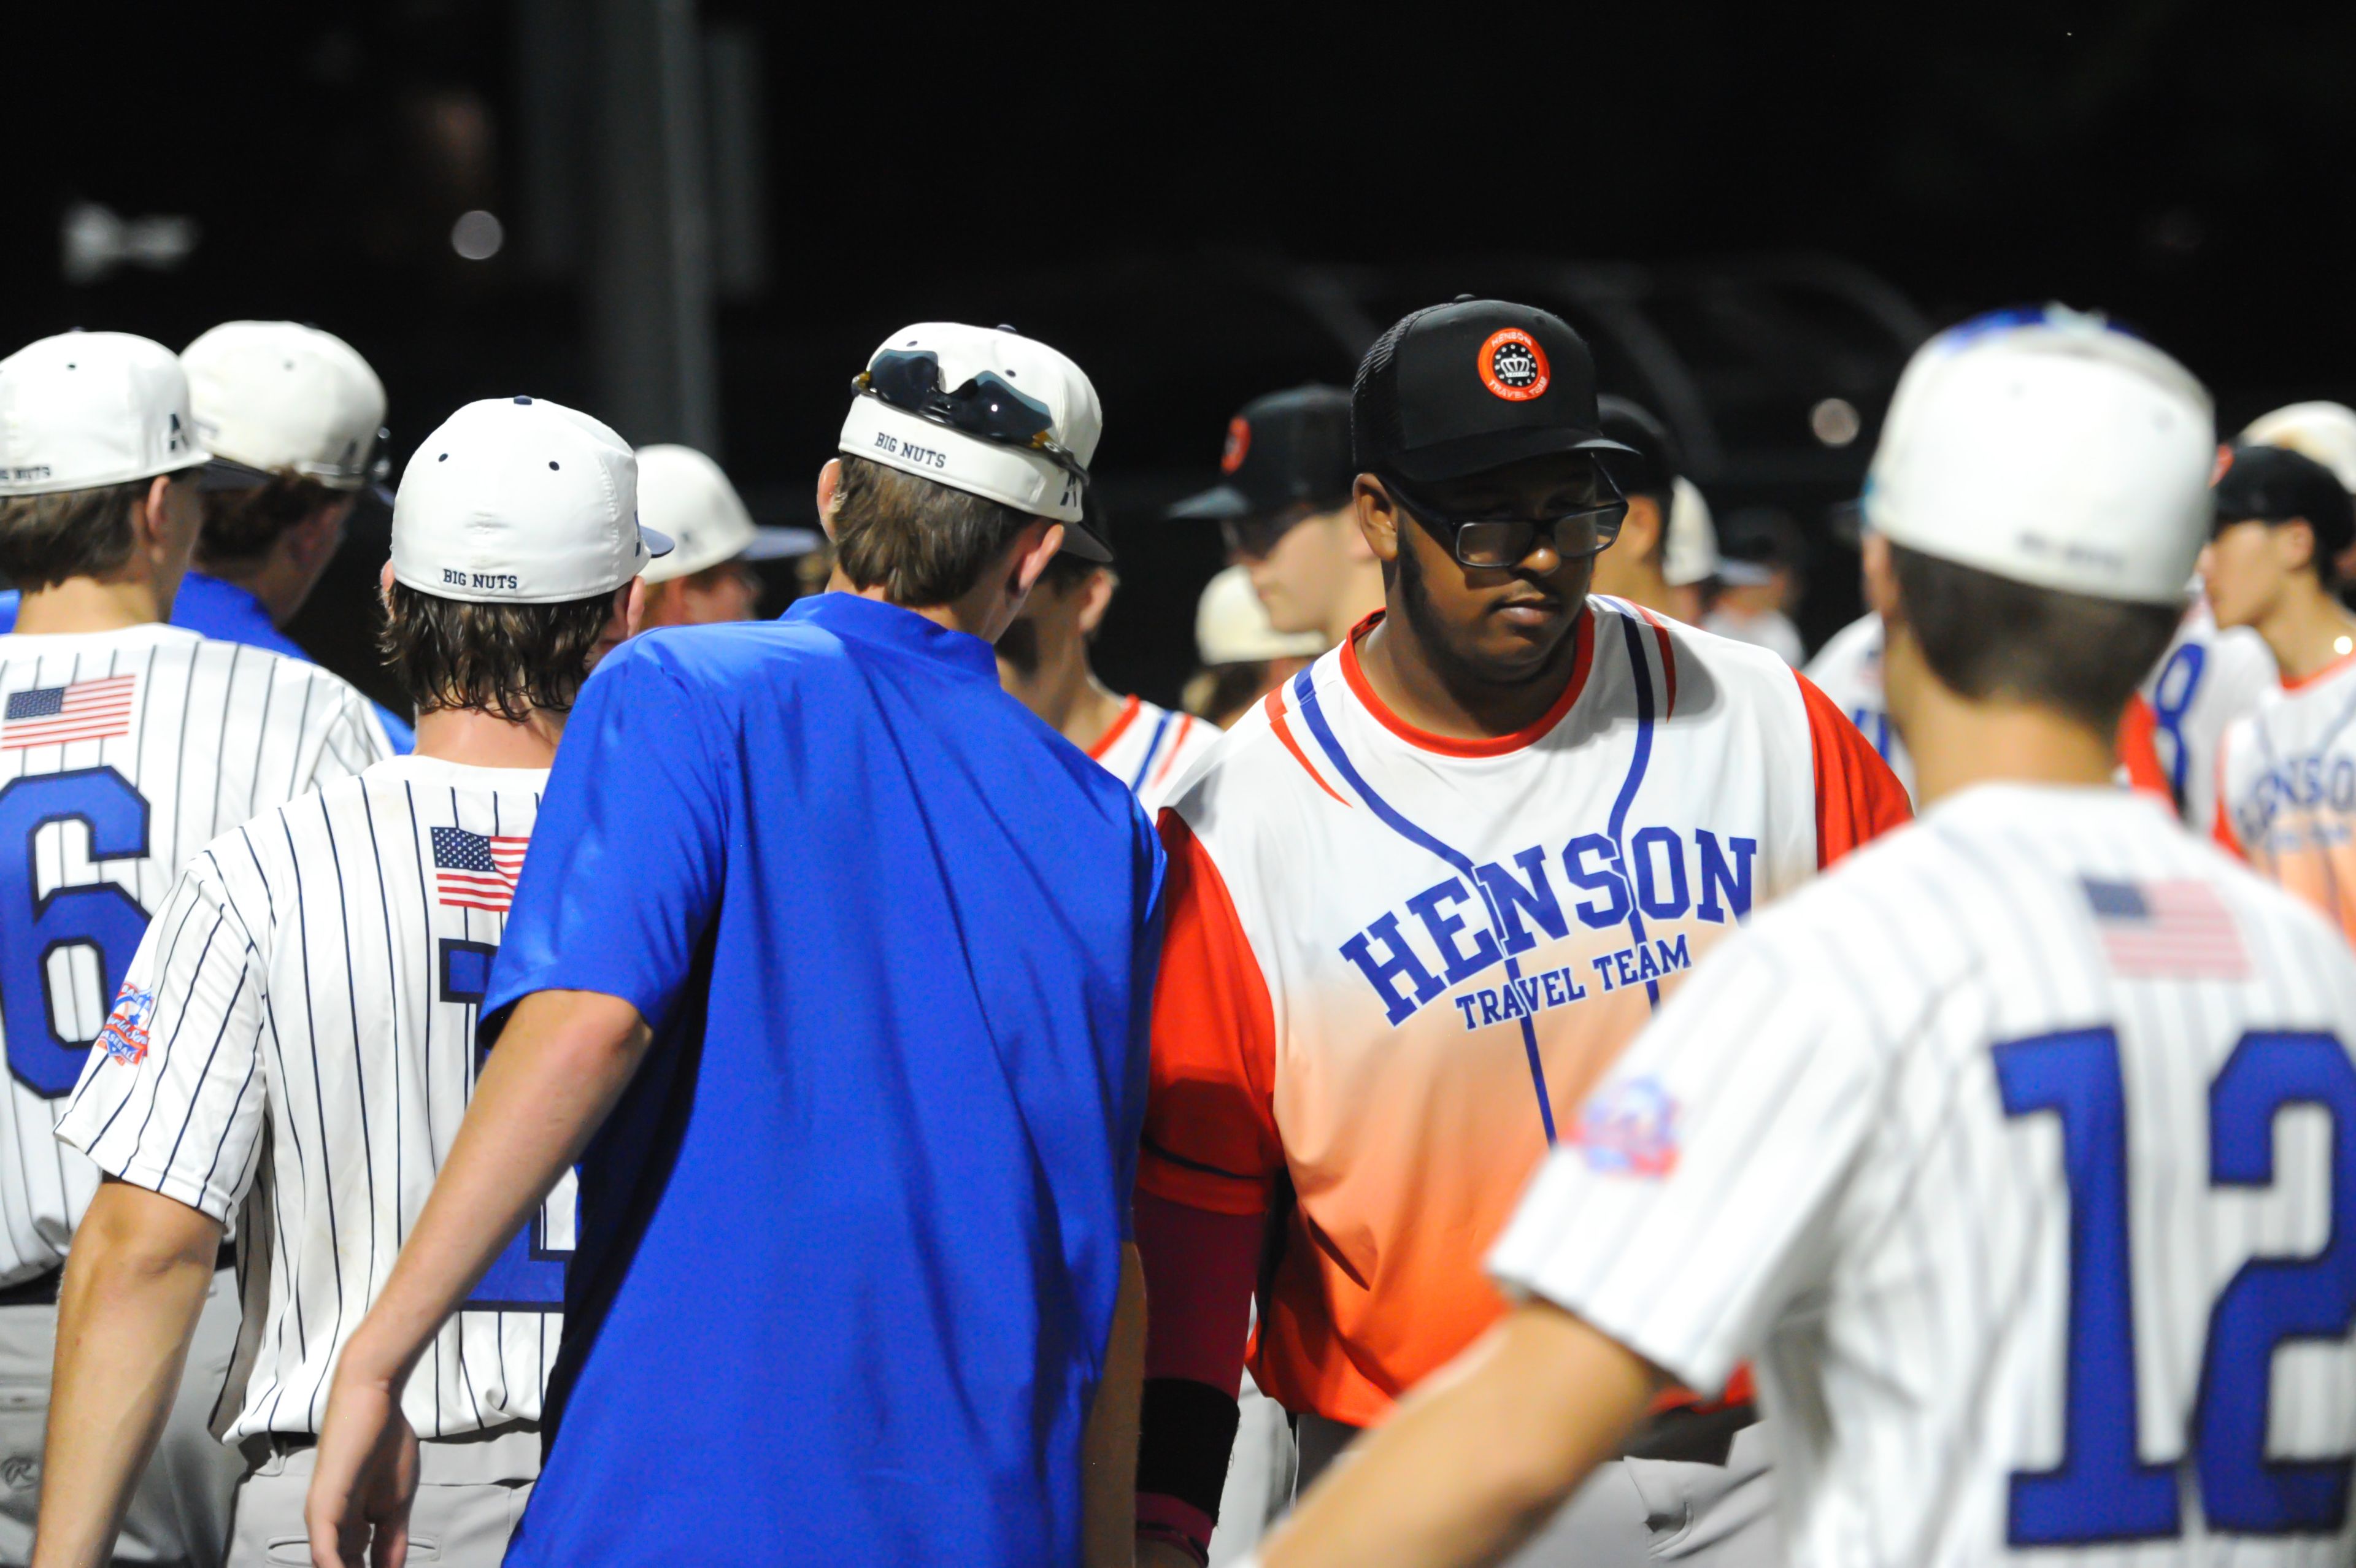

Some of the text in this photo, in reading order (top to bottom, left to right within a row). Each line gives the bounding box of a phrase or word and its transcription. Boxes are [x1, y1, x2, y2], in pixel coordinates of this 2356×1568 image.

[1492, 332, 1532, 348] HENSON
[1489, 375, 1547, 398] TRAVEL TEAM
[874, 432, 946, 468] BIG NUTS
[443, 569, 517, 589] BIG NUTS
[0, 765, 153, 1100] 6
[1338, 826, 1757, 1028] HENSON
[1455, 934, 1692, 1030] TRAVEL TEAM
[1992, 1026, 2356, 1546] 12
